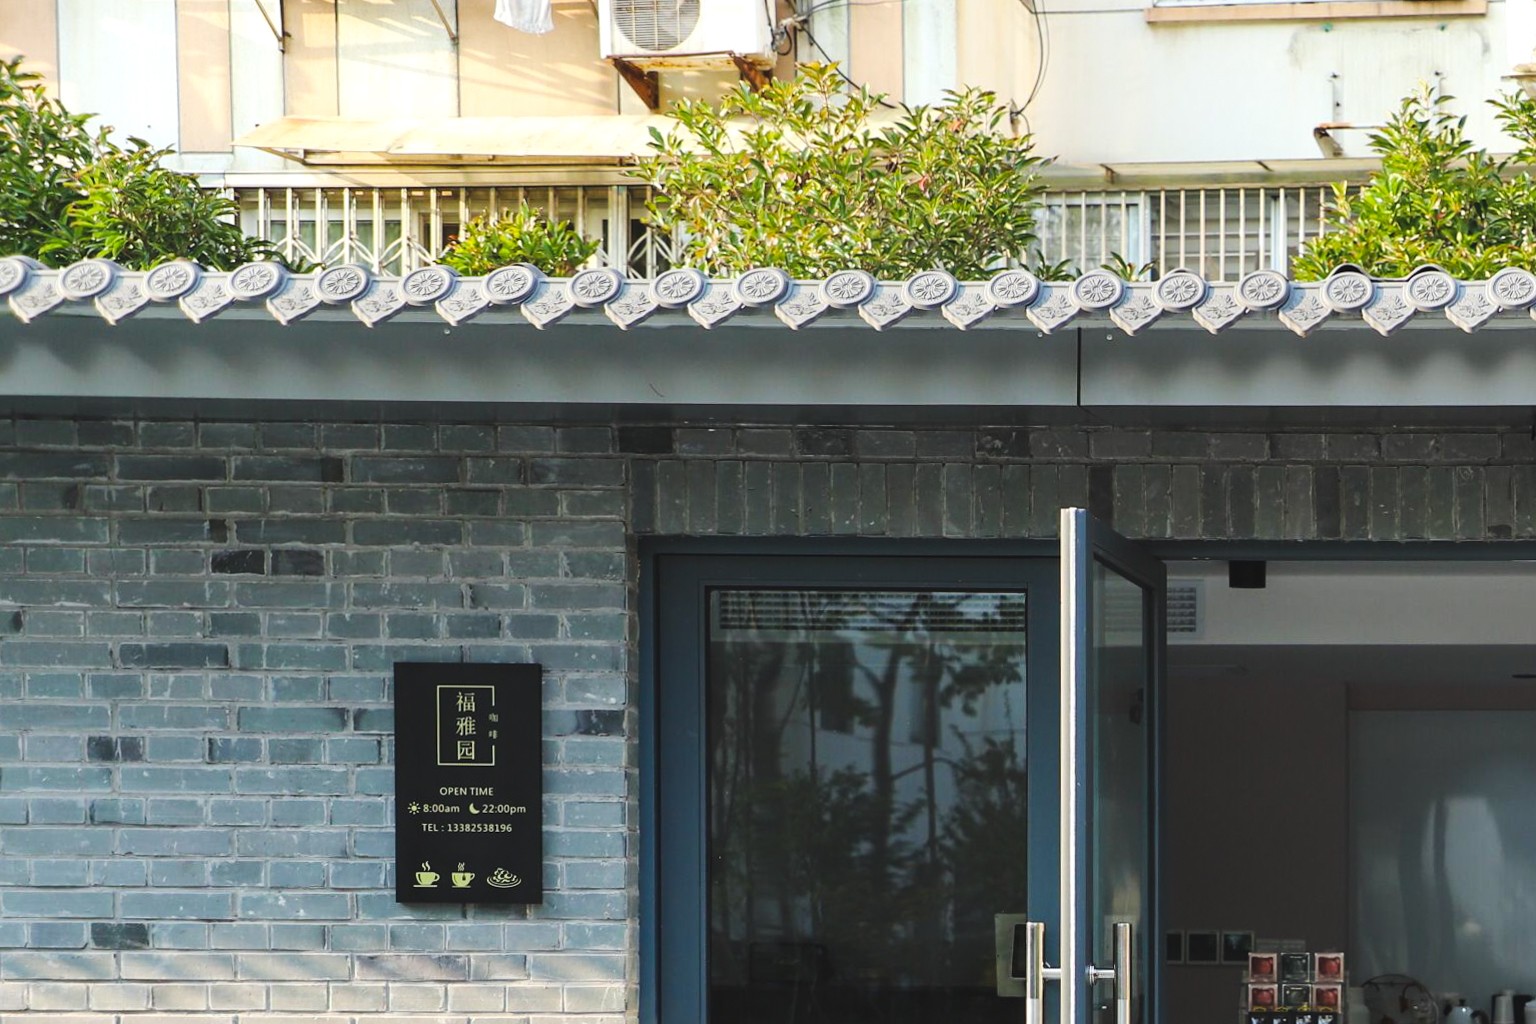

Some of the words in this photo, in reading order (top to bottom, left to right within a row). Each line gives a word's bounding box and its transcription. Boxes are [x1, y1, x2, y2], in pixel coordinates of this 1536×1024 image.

[456, 691, 476, 760] 福雅园
[439, 786, 468, 796] OPEN
[469, 786, 494, 796] TIME
[422, 803, 460, 813] 8:00am
[481, 804, 527, 815] 22:00pm
[447, 823, 513, 833] 13382538196
